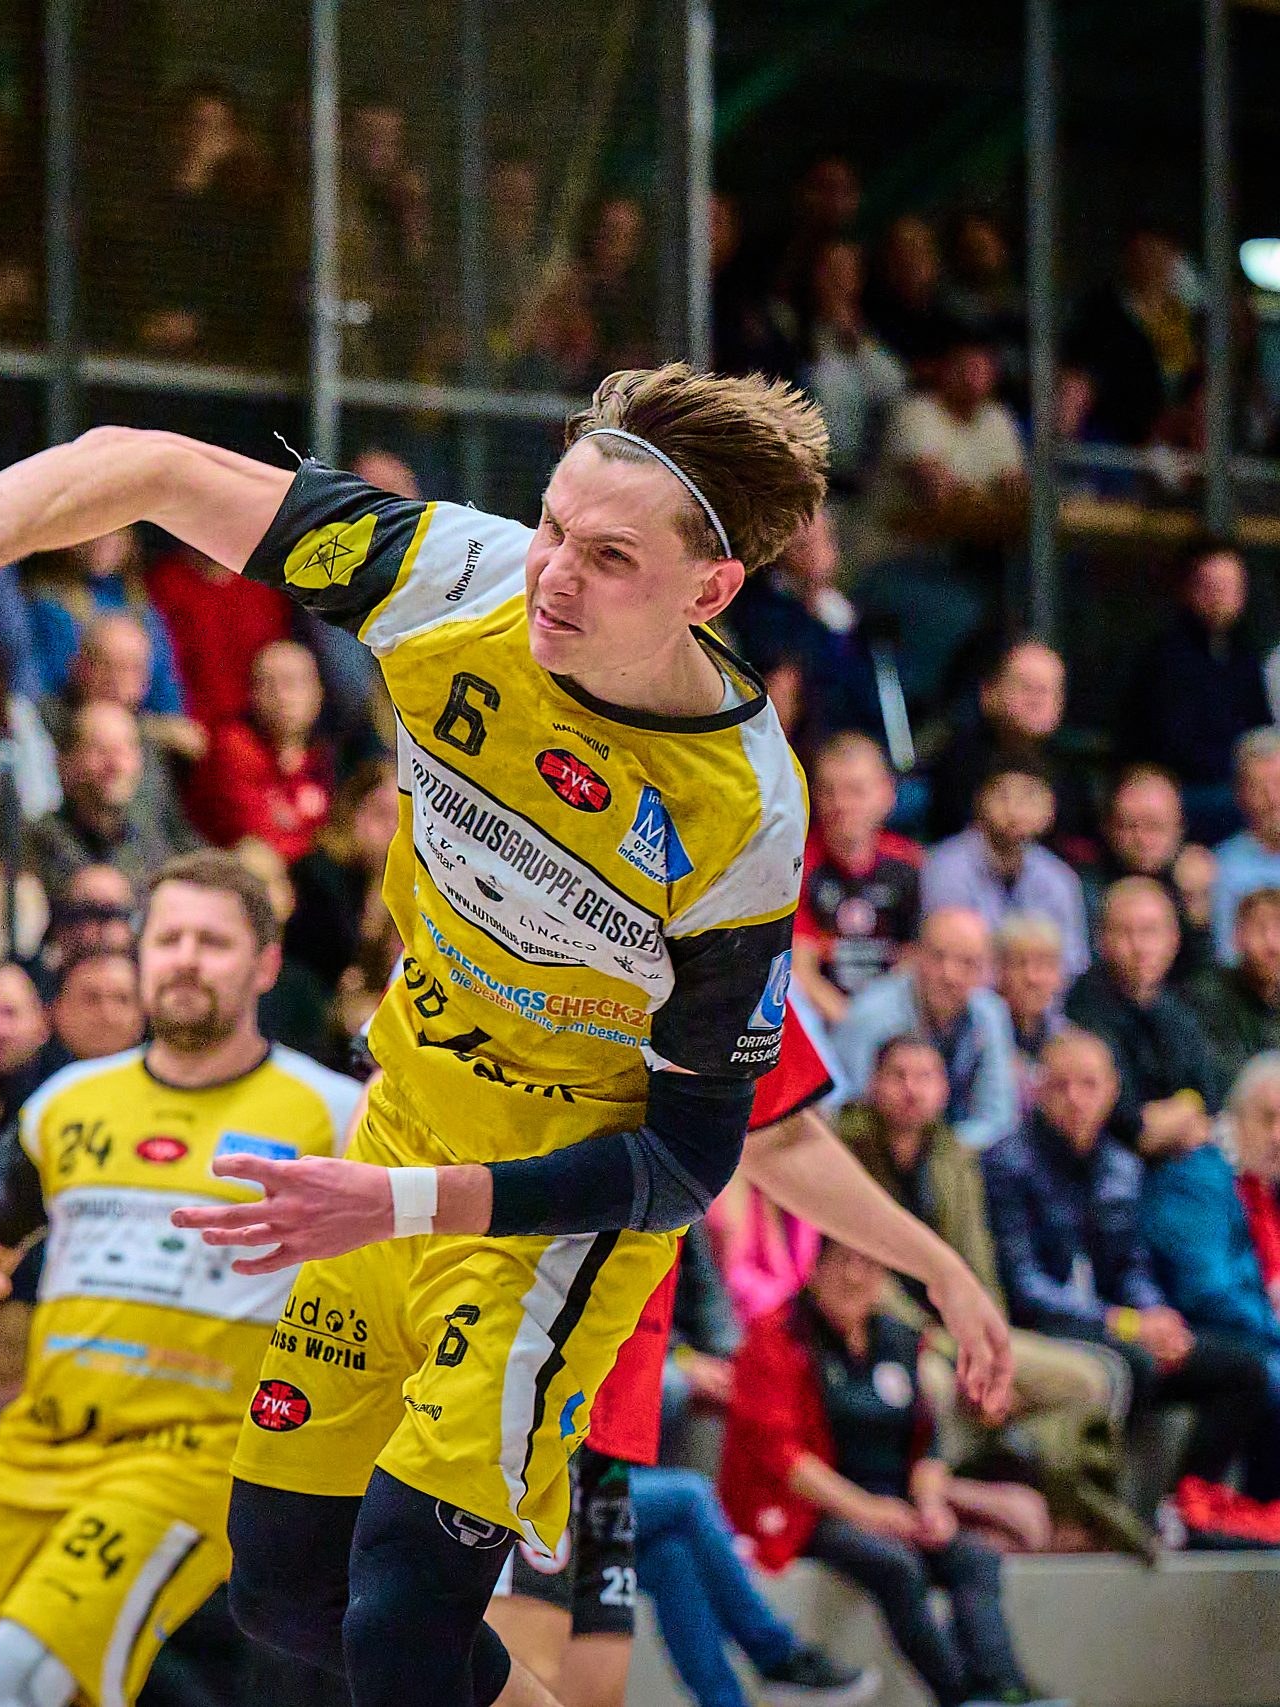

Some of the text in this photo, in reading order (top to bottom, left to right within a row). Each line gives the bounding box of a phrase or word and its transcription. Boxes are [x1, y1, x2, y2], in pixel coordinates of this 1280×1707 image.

[445, 539, 484, 602] HALLENKIND
[434, 672, 501, 757] 6
[561, 765, 593, 796] TVK
[633, 839, 658, 863] 0721
[450, 968, 473, 989] Die
[472, 983, 516, 1012] besten
[554, 1020, 584, 1035] zm
[587, 1022, 637, 1048] besten
[59, 1121, 113, 1175] 24
[305, 1336, 366, 1371] World
[435, 1303, 481, 1368] 6
[261, 1395, 292, 1417] TVK
[63, 1516, 126, 1581] 24
